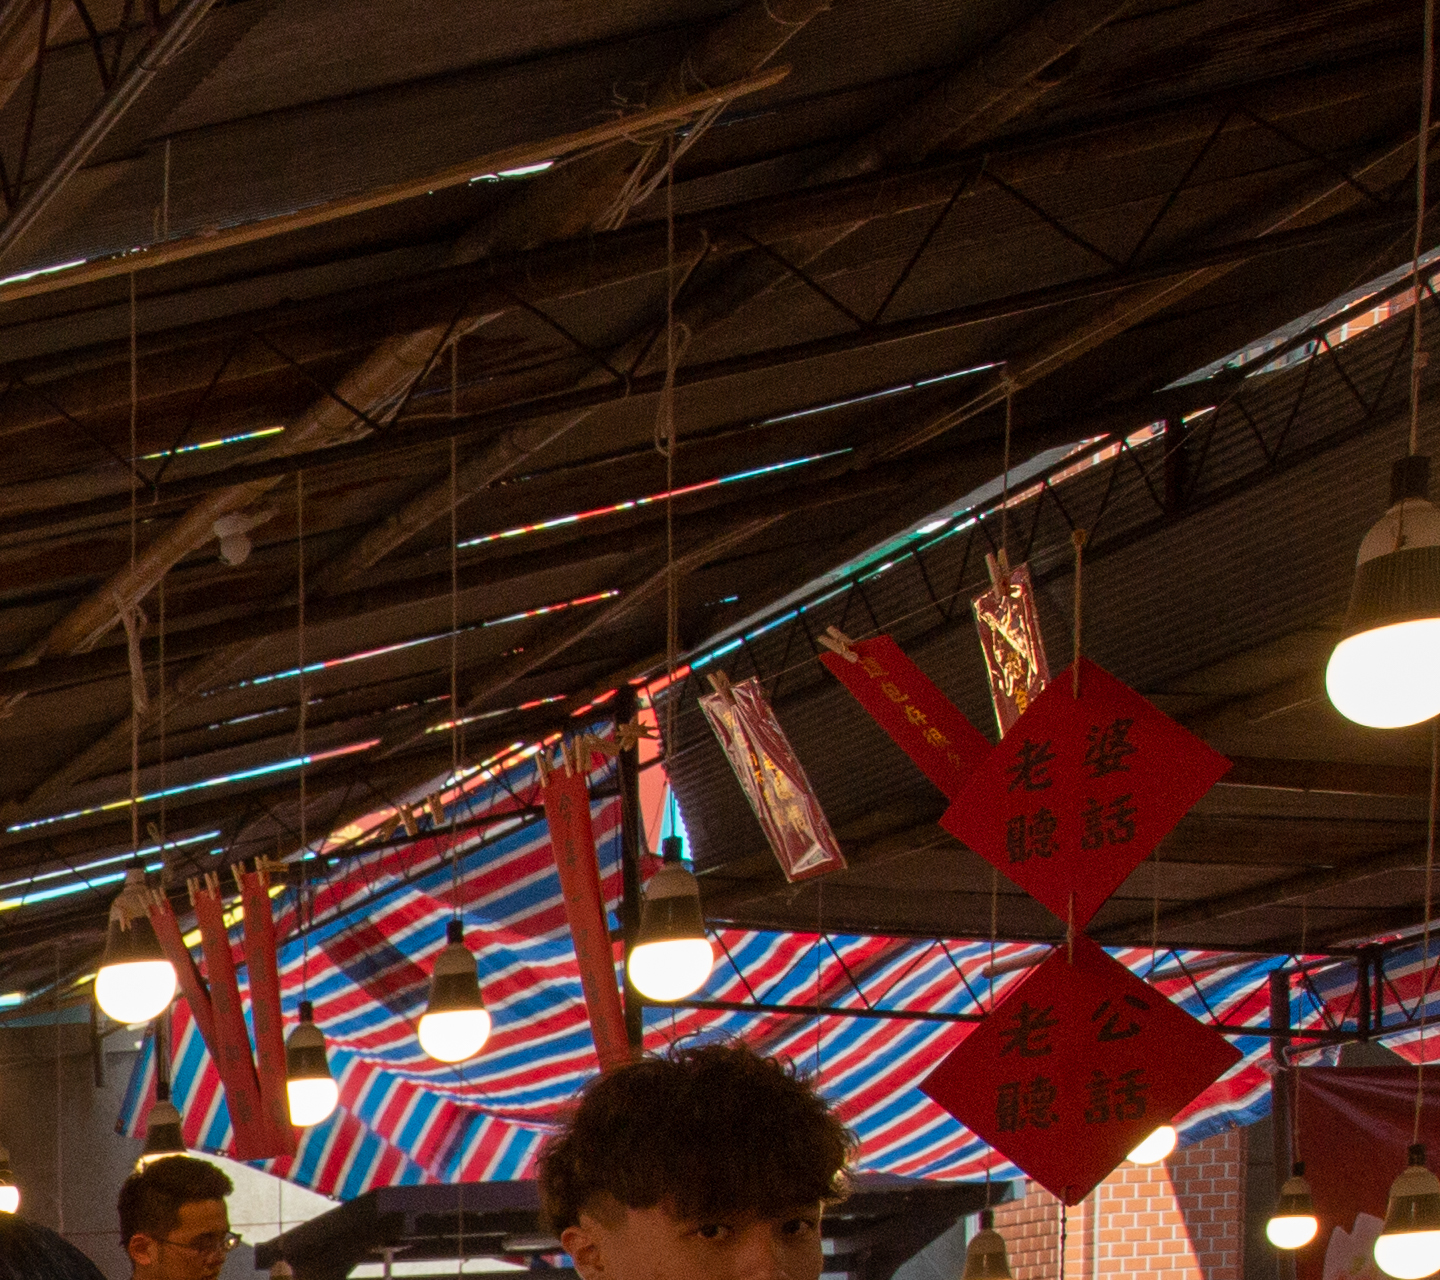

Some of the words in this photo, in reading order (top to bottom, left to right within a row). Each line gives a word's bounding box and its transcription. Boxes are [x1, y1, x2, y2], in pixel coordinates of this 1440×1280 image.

[1005, 718, 1139, 795] 老婆
[1006, 793, 1138, 865] 聽話
[997, 990, 1151, 1060] 老公
[994, 1066, 1152, 1135] 聽話
